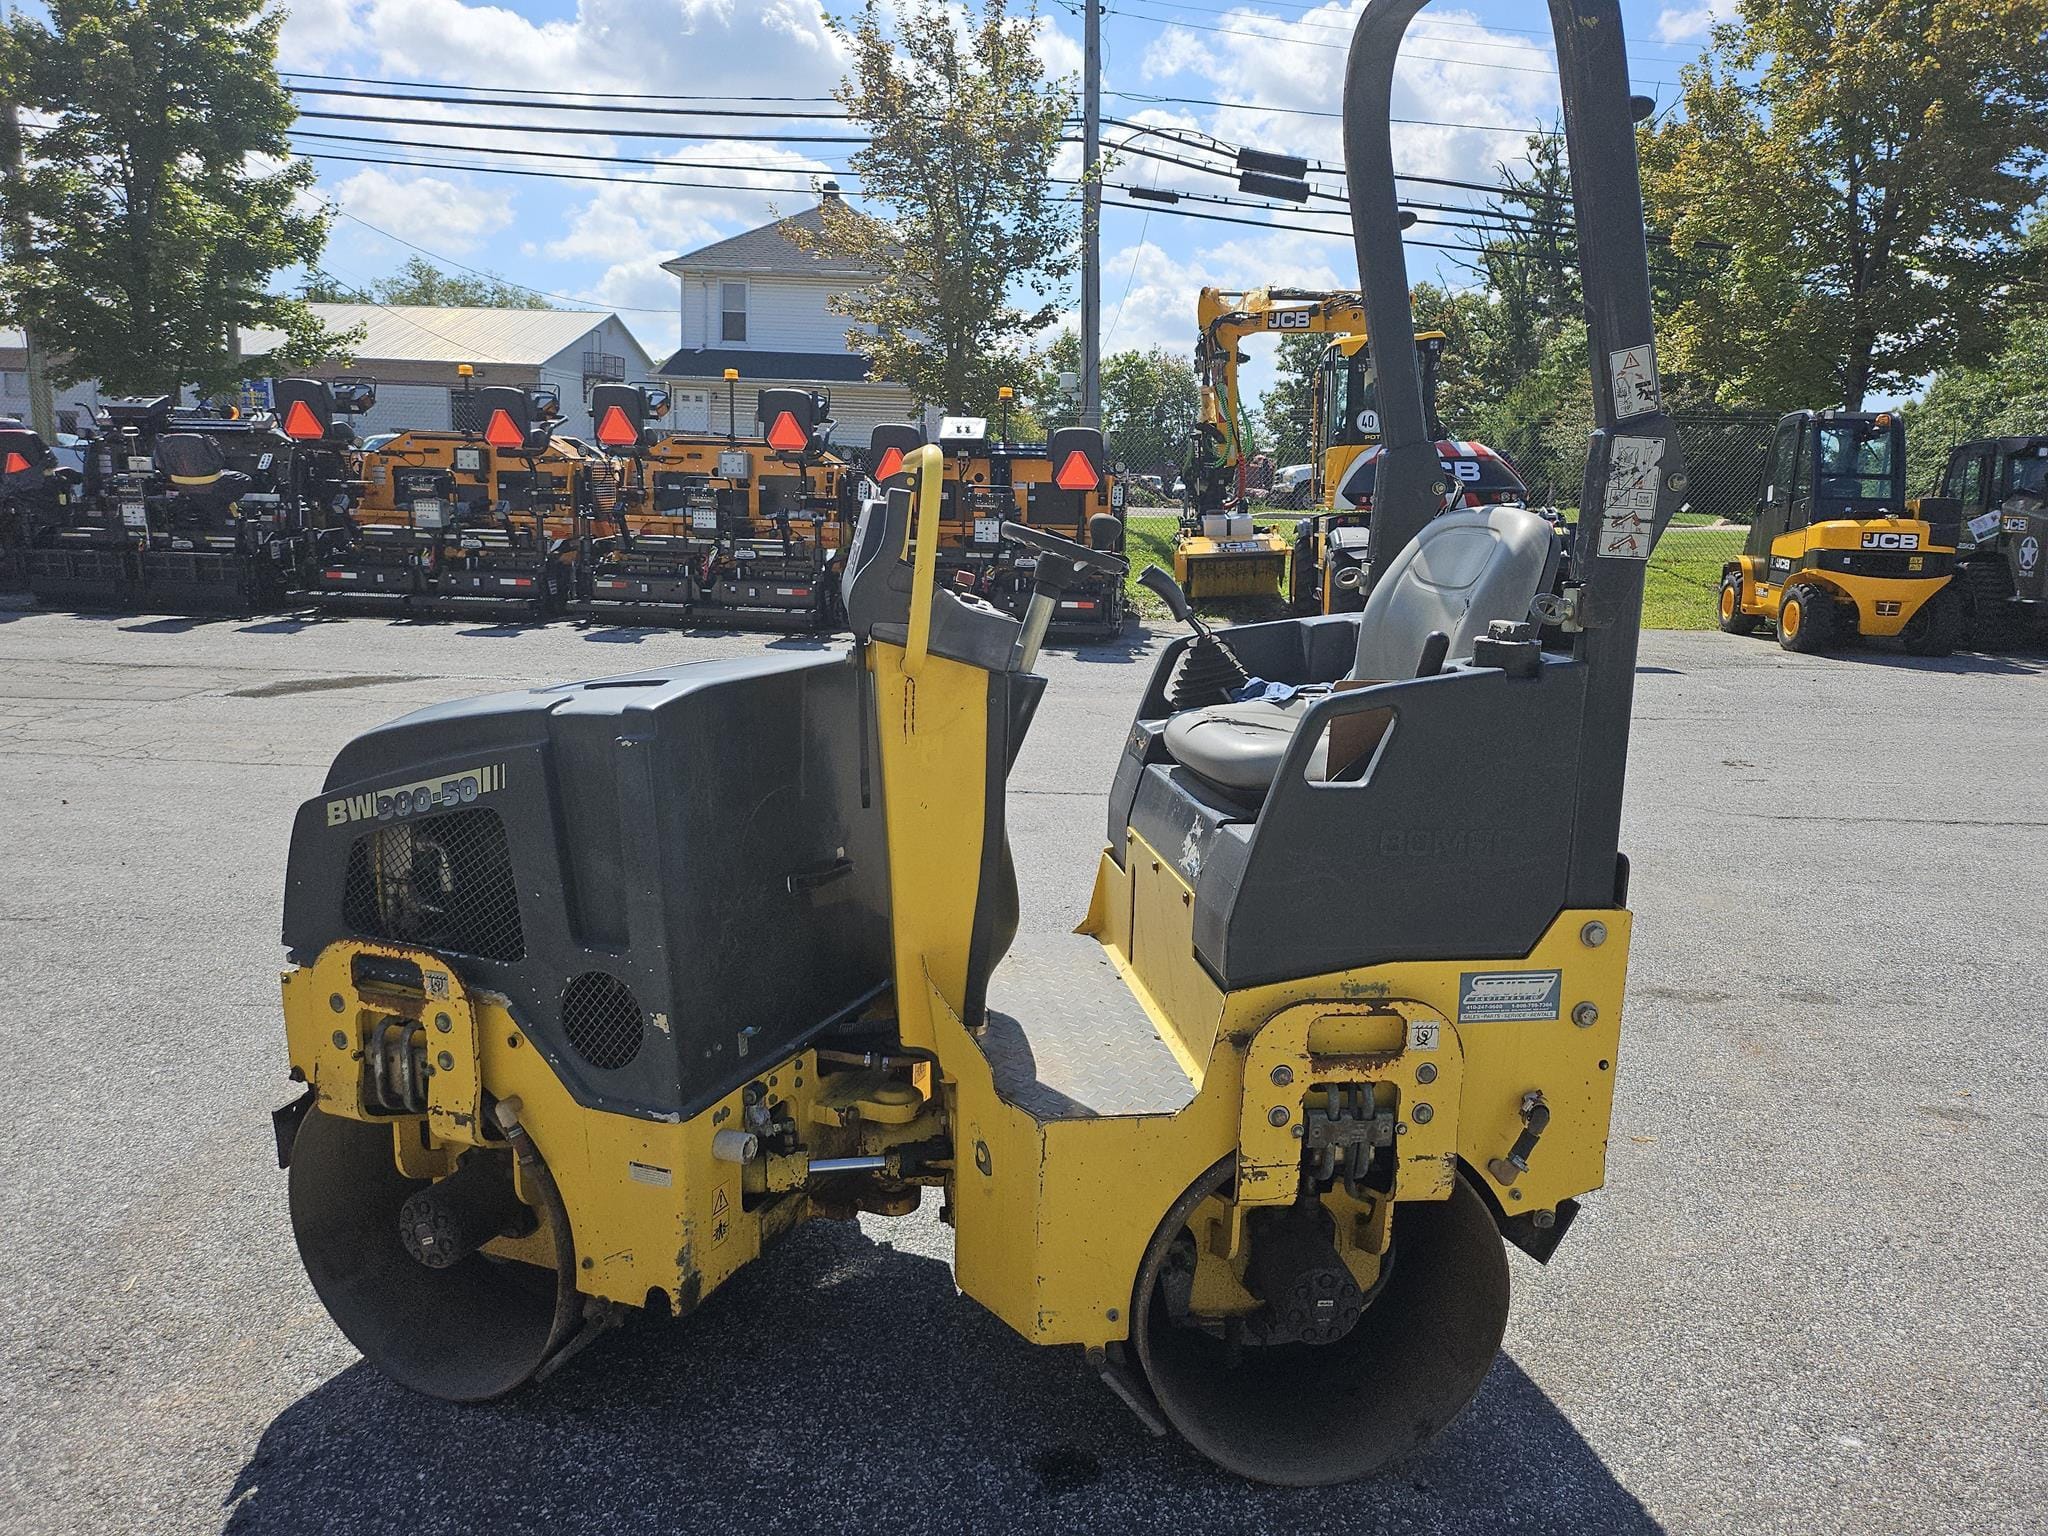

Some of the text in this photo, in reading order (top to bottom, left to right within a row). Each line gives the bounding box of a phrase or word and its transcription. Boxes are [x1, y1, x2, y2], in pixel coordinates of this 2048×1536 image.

[1268, 311, 1310, 328] JCB
[1361, 414, 1375, 428] 40
[2003, 518, 2027, 531] JCB
[1862, 533, 1919, 549] JCB
